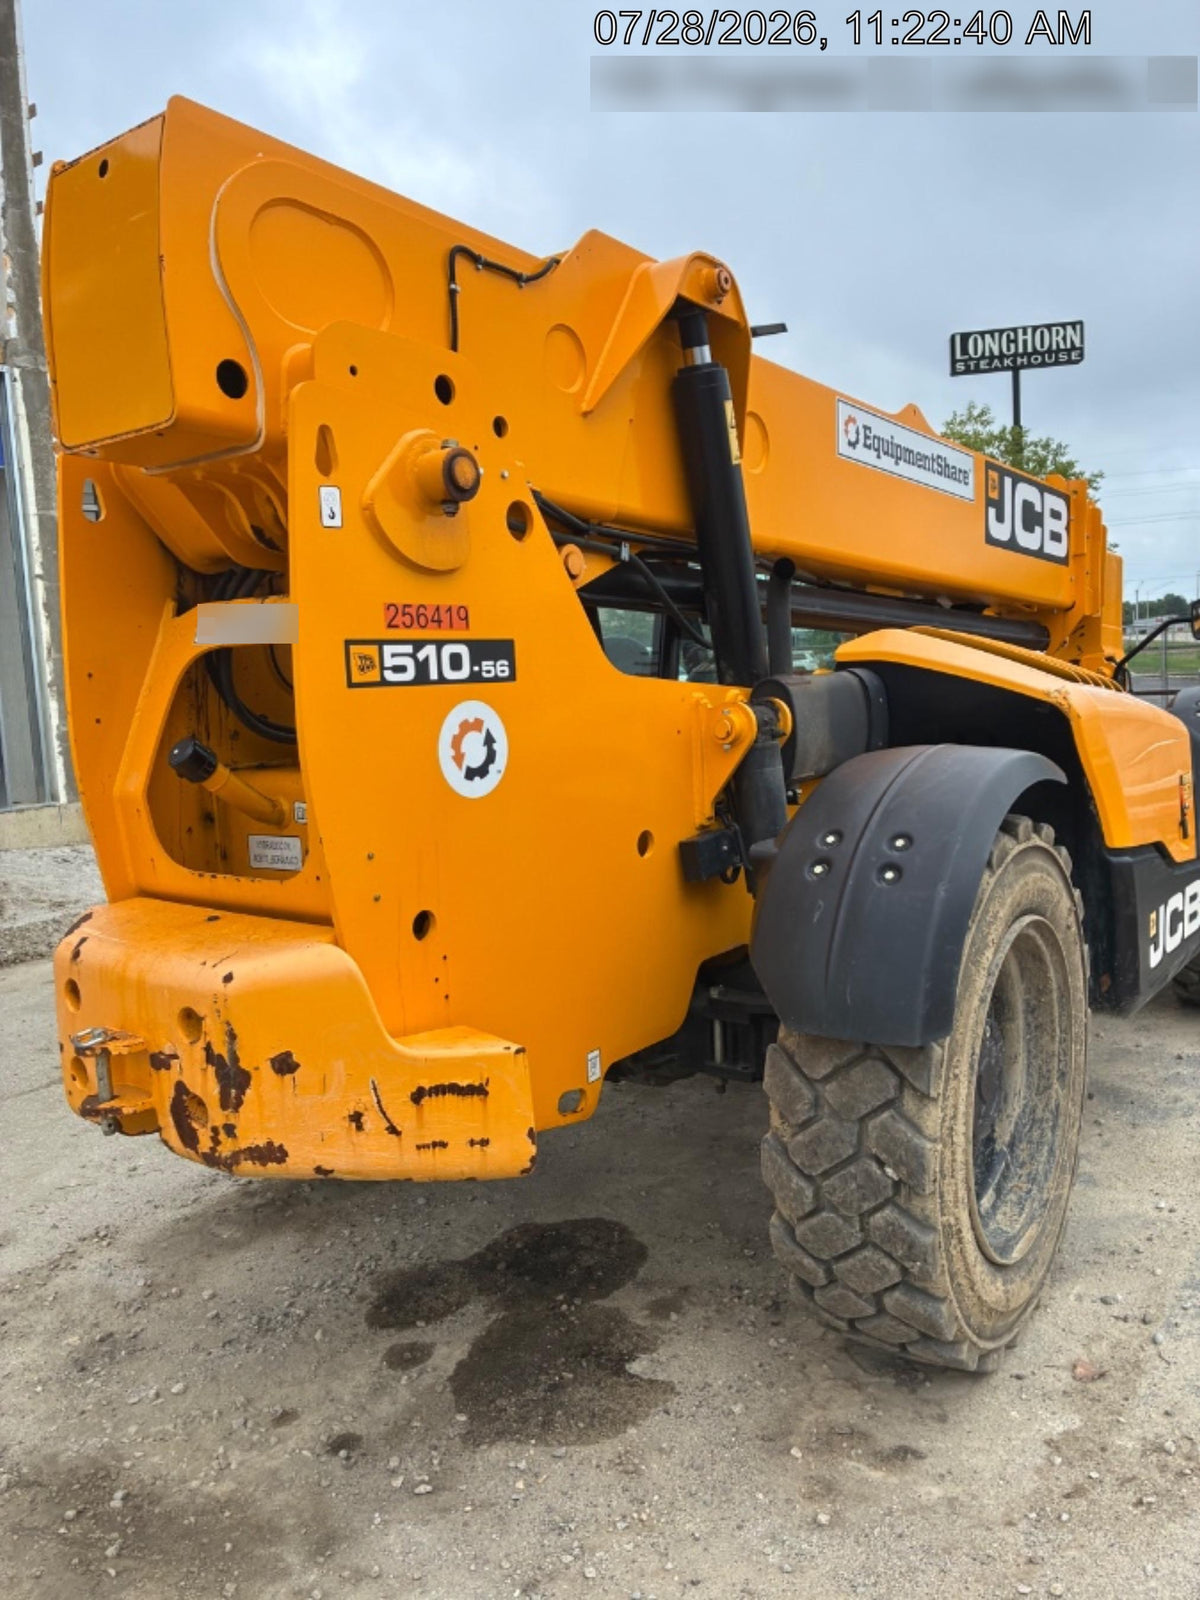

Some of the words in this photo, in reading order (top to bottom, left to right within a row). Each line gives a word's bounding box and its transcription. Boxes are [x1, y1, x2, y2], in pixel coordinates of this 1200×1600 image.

[955, 324, 1084, 360] LONGHORN
[955, 349, 1081, 373] STEAKHOUSE
[861, 423, 971, 487] EquipmentShare
[988, 475, 1068, 558] JCB
[386, 603, 469, 630] 256419
[1149, 879, 1200, 969] JCB
